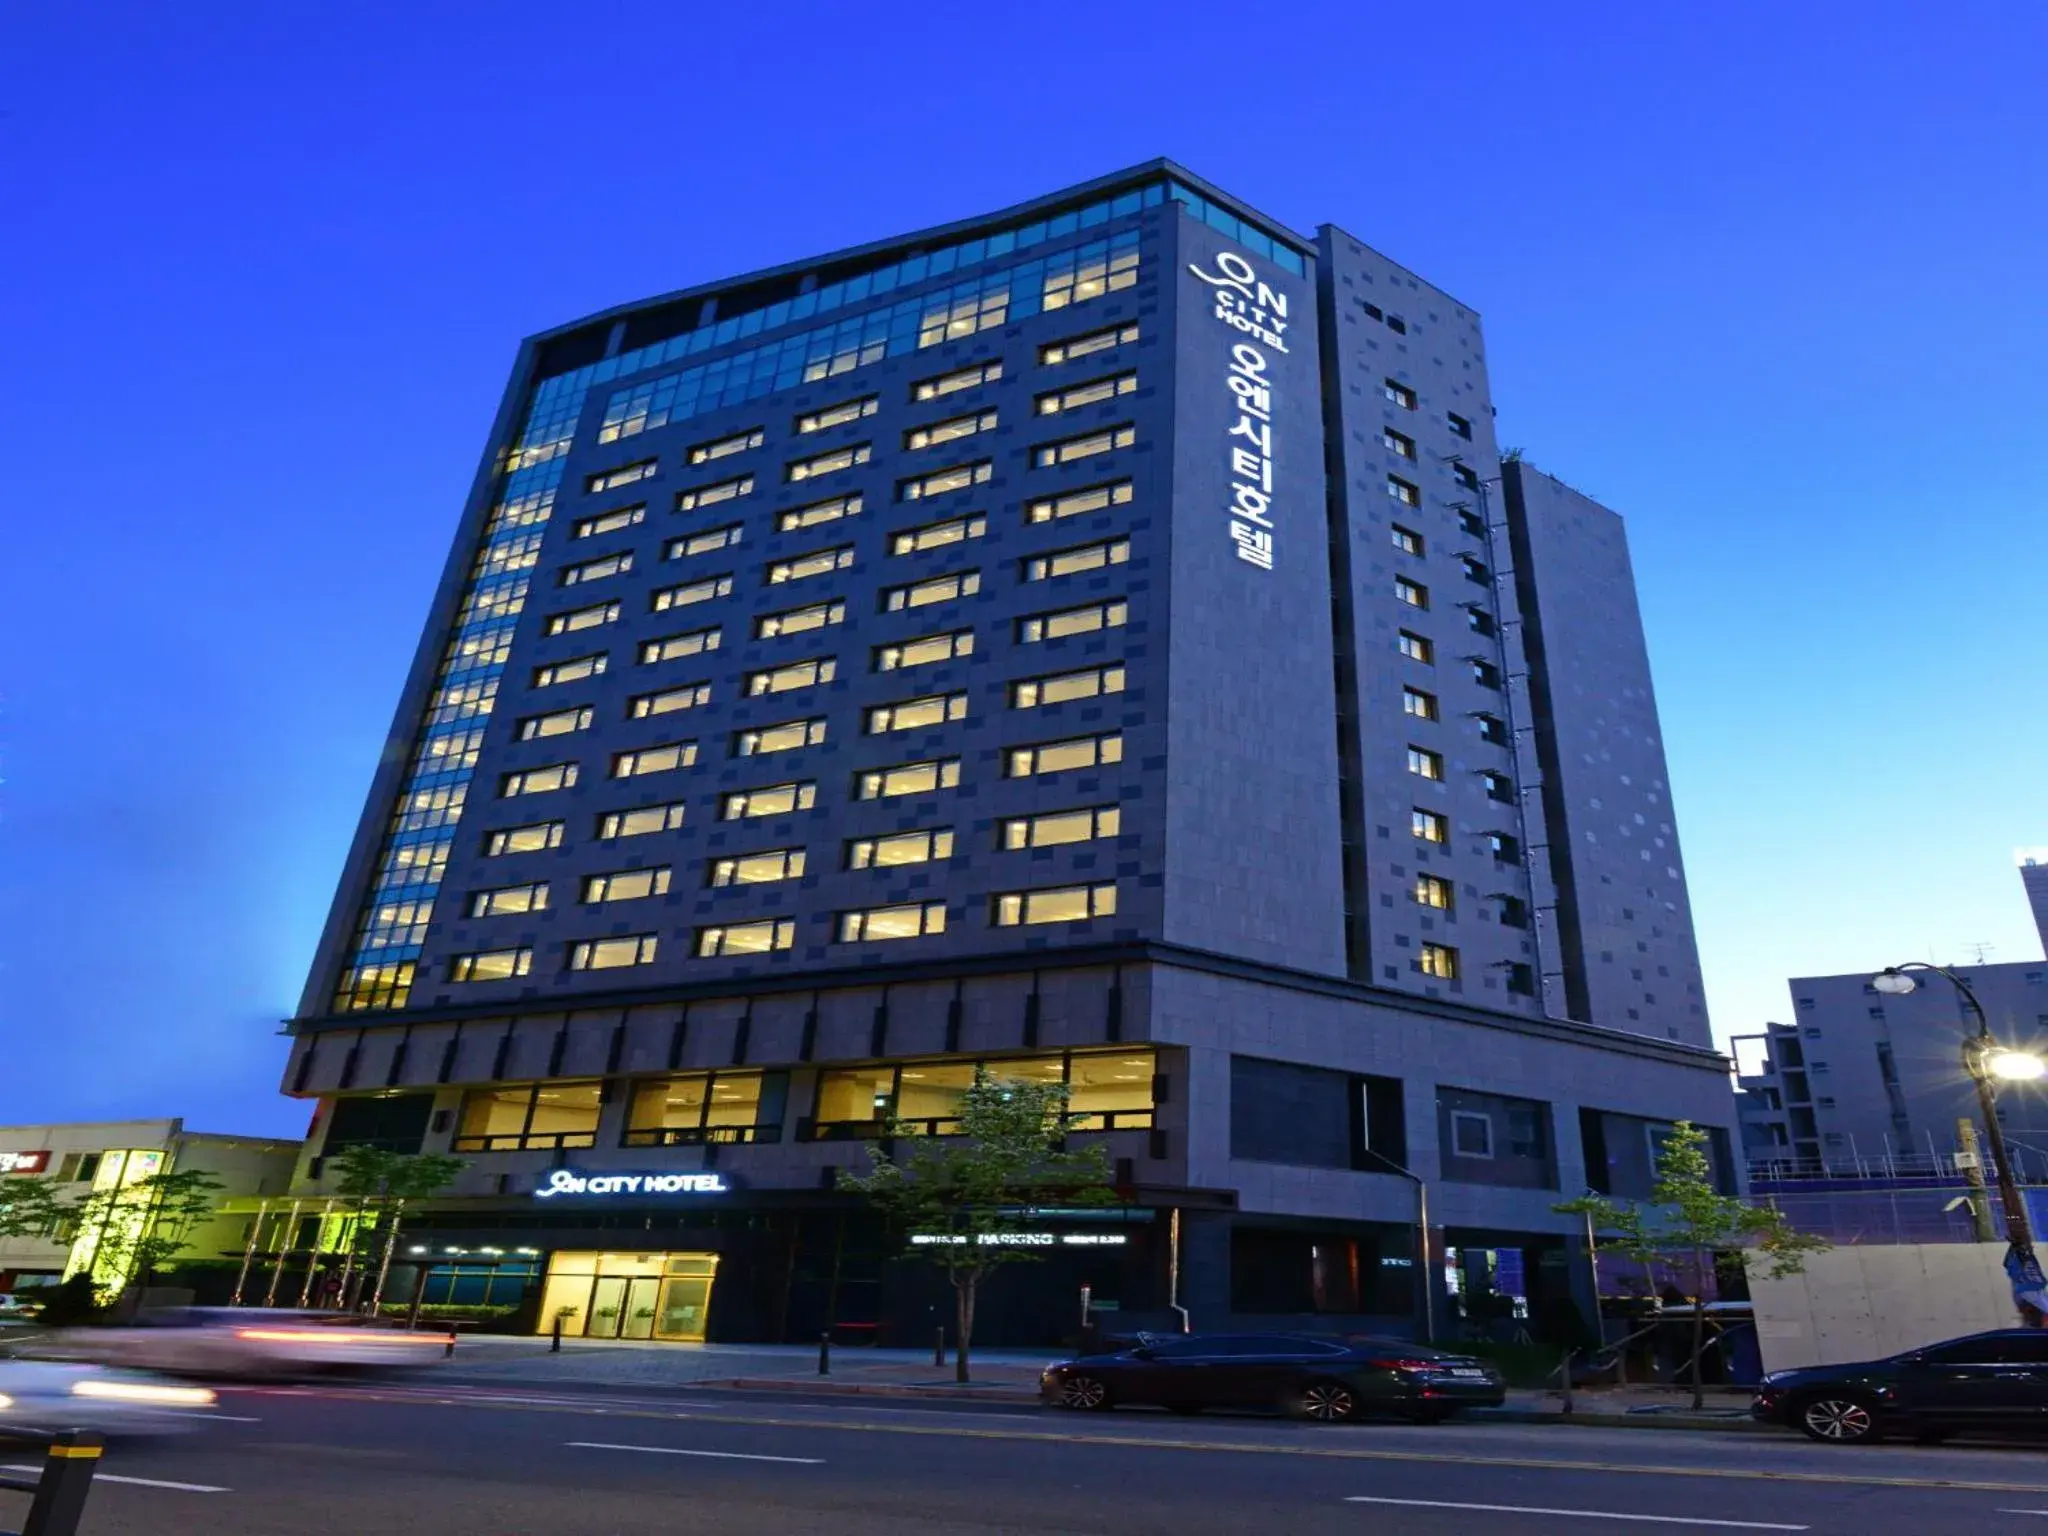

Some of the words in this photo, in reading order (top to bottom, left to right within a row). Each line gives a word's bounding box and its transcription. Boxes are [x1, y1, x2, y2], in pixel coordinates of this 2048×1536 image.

[1189, 252, 1287, 318] ON
[1216, 290, 1287, 333] CITY
[1216, 305, 1289, 353] HOTEL
[1227, 344, 1274, 570] 오엔시티호텔
[535, 1170, 586, 1197] ON
[587, 1176, 642, 1193] CITY
[644, 1174, 727, 1193] HOTEL
